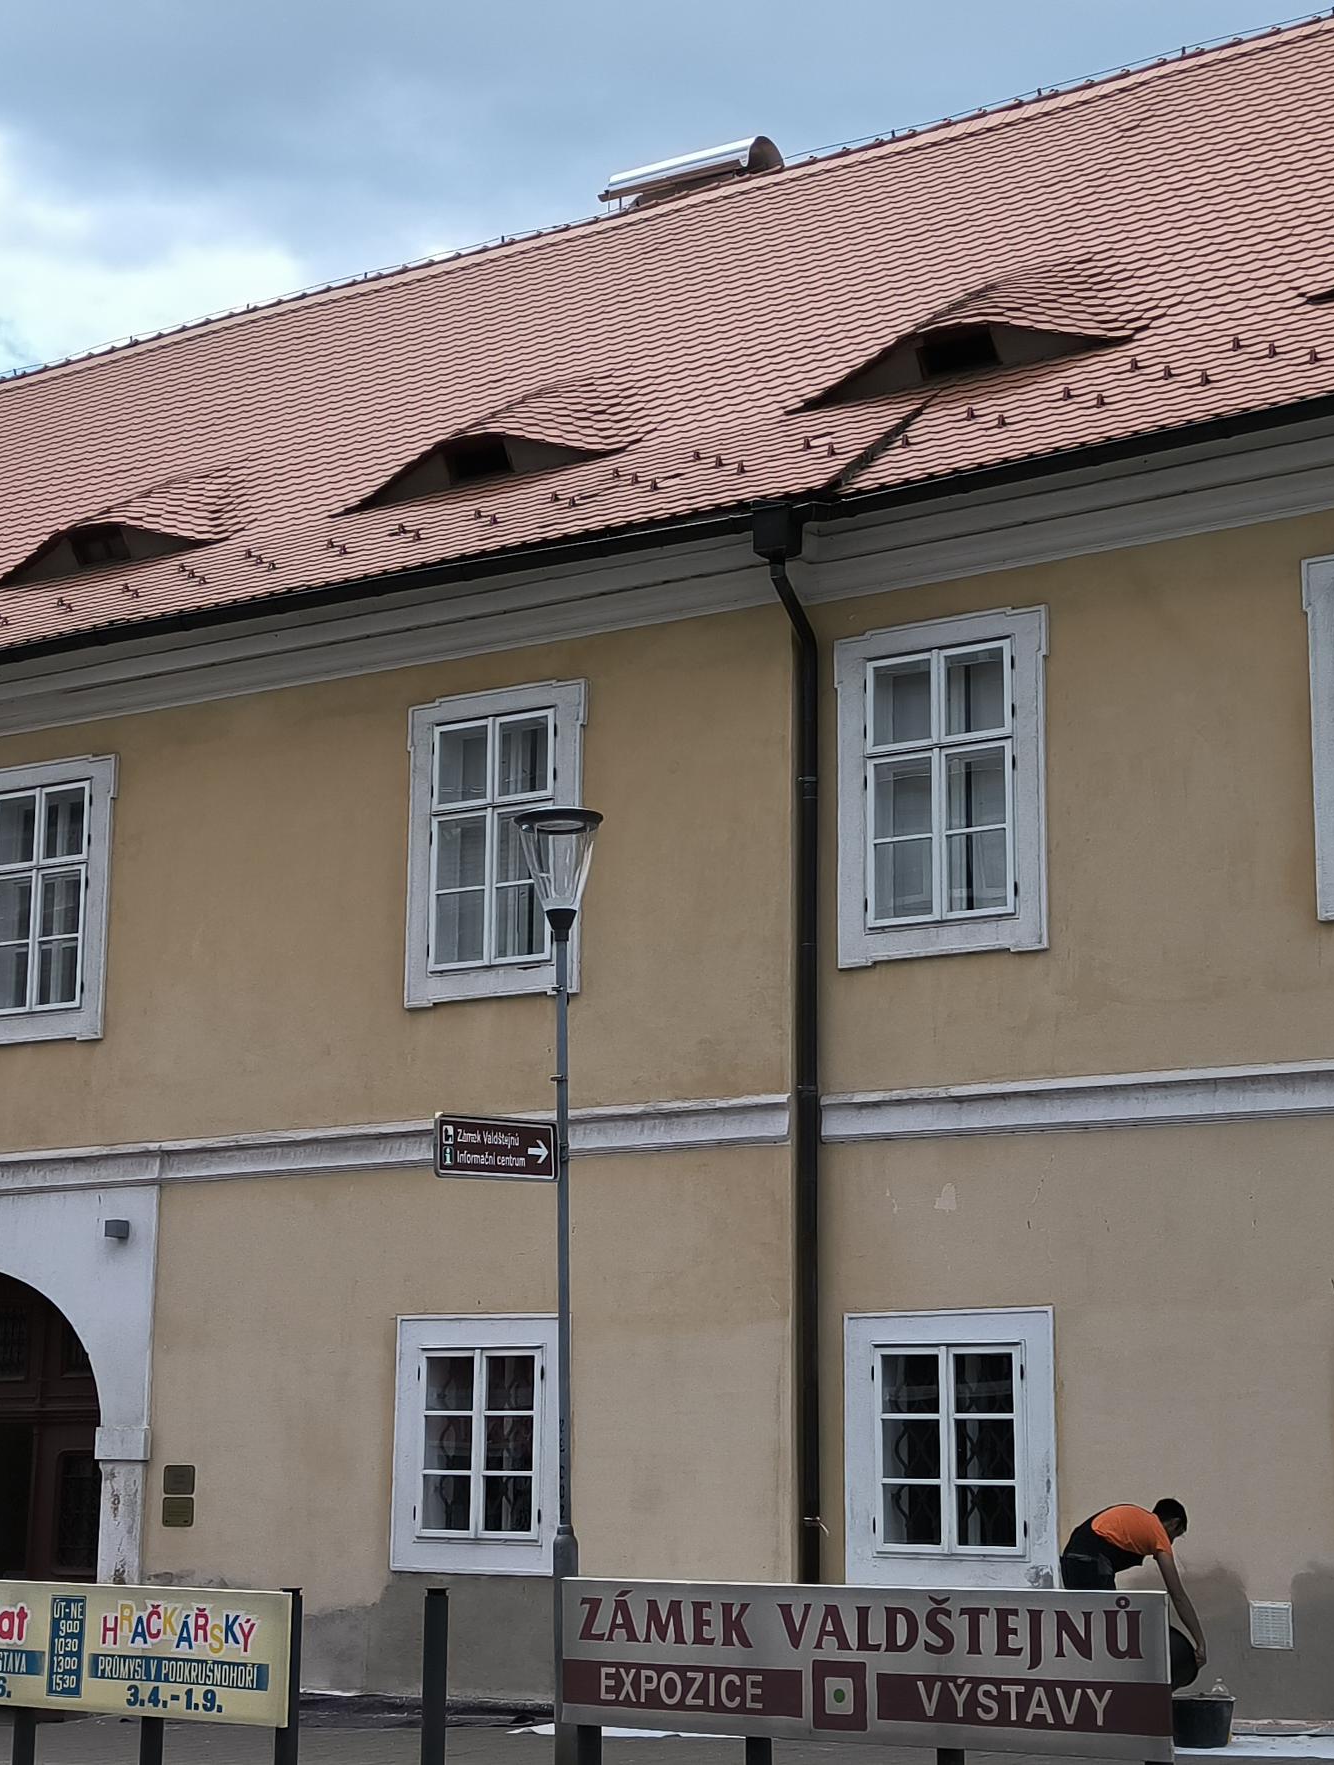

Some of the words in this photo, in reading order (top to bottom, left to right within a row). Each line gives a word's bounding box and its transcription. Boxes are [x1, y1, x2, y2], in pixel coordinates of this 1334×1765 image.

[457, 1150, 496, 1165] Informační
[497, 1154, 526, 1167] centrum
[53, 1600, 84, 1619] ÚT-NE
[101, 1603, 257, 1654] HRAČKÁŘSKÝ
[578, 1589, 753, 1649] ZÁMEK
[775, 1594, 1144, 1671] VALDŠTEJNŮ
[97, 1655, 147, 1680] PRŮMYSL
[150, 1659, 158, 1680] V
[161, 1660, 259, 1689] PODKRUŠNOHOŘÍ
[599, 1667, 764, 1709] EXPOZICE
[916, 1677, 1113, 1727] VÝSTAVY
